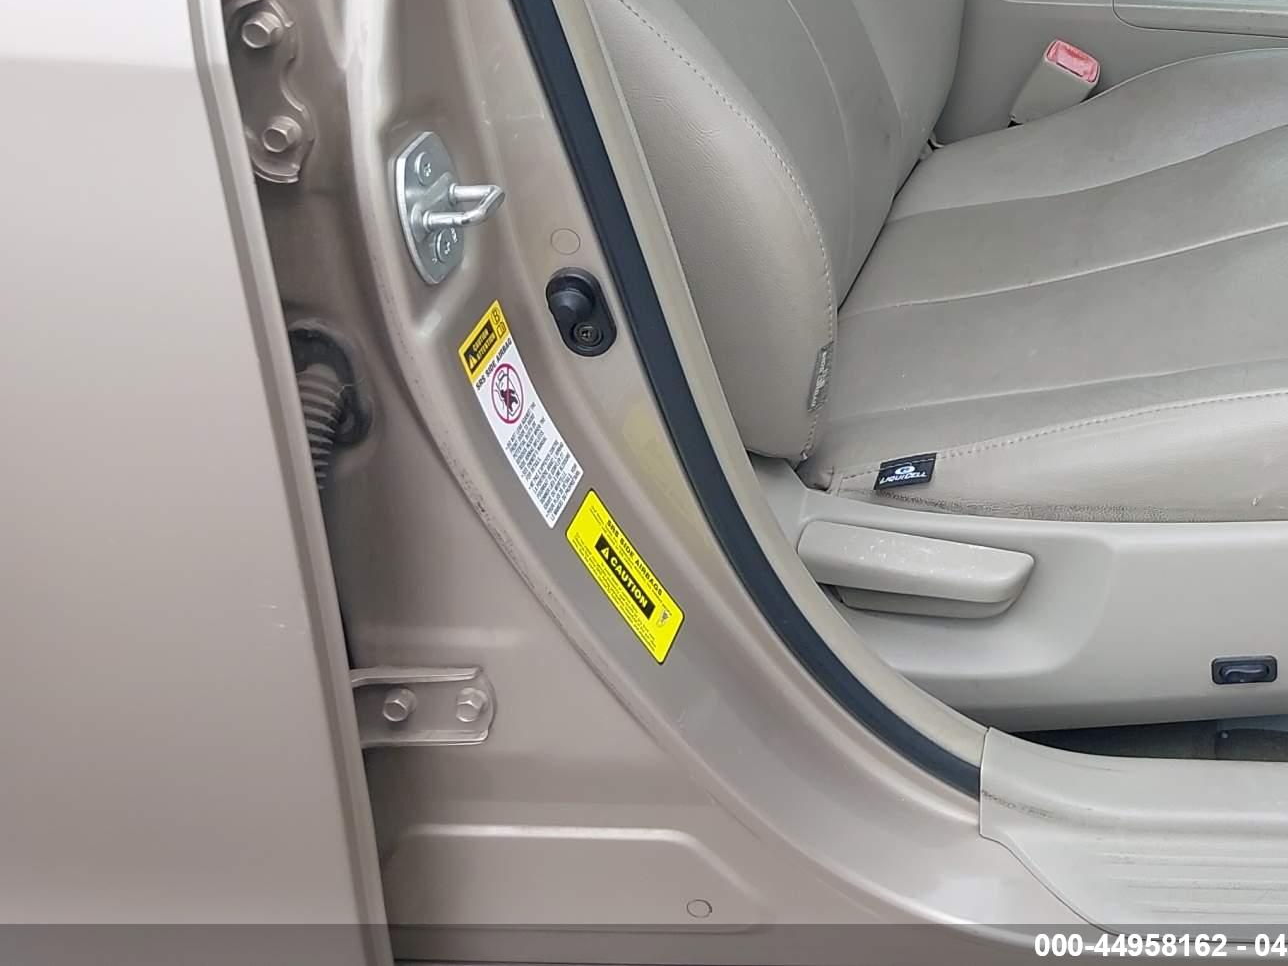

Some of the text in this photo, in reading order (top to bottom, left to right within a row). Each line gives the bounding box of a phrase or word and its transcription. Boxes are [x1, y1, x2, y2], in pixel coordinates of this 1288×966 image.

[472, 328, 489, 352] CAUTION
[476, 332, 496, 360] ATTENTION
[475, 375, 486, 391] SRS
[485, 361, 496, 378] SIDE
[496, 338, 512, 362] AIRBAG
[880, 471, 927, 484] LIQUICELL
[606, 519, 663, 597] SRS SIDE AIRBAGS
[609, 554, 648, 610] CAUTION
